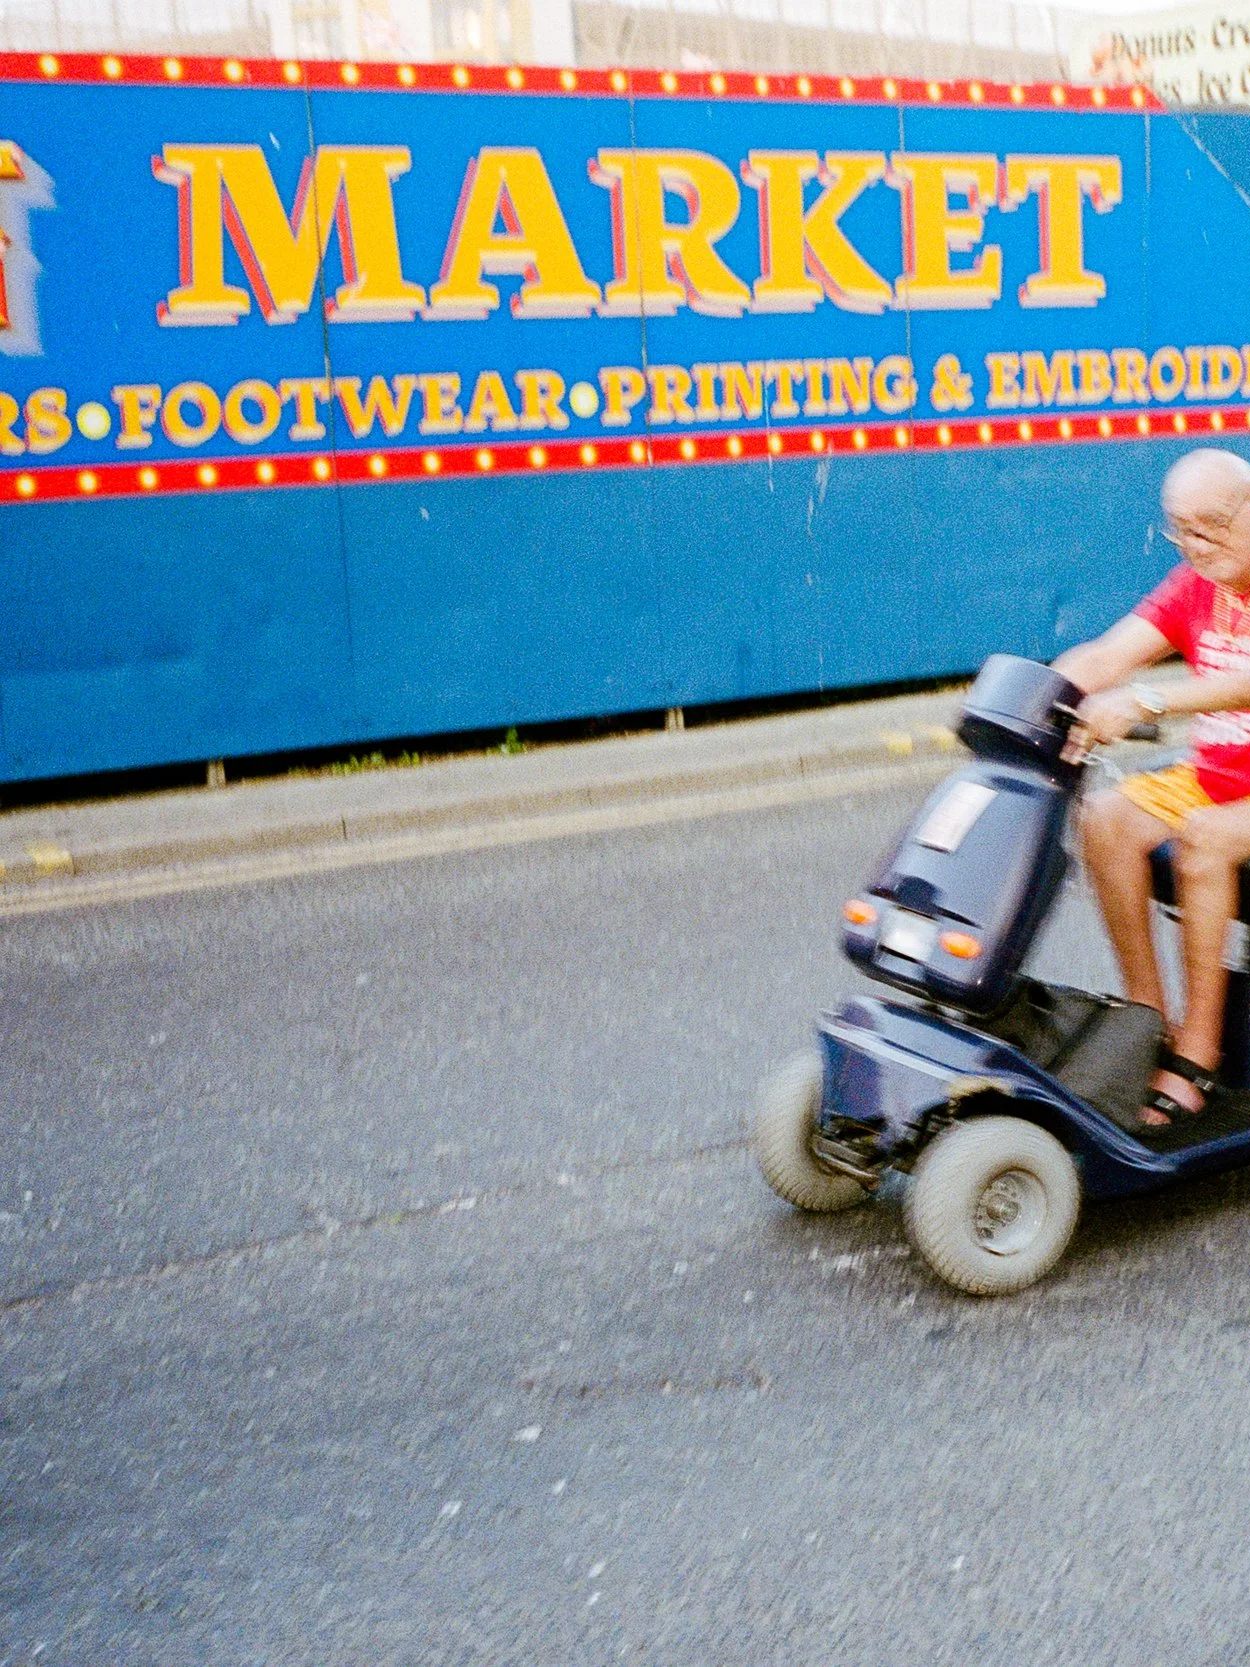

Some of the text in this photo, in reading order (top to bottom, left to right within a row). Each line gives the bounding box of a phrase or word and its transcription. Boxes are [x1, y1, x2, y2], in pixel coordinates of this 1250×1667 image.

[152, 143, 1121, 327] MARKET
[111, 367, 567, 449] FOOTWEAR
[598, 353, 918, 430] PRINTING
[931, 353, 973, 411] &
